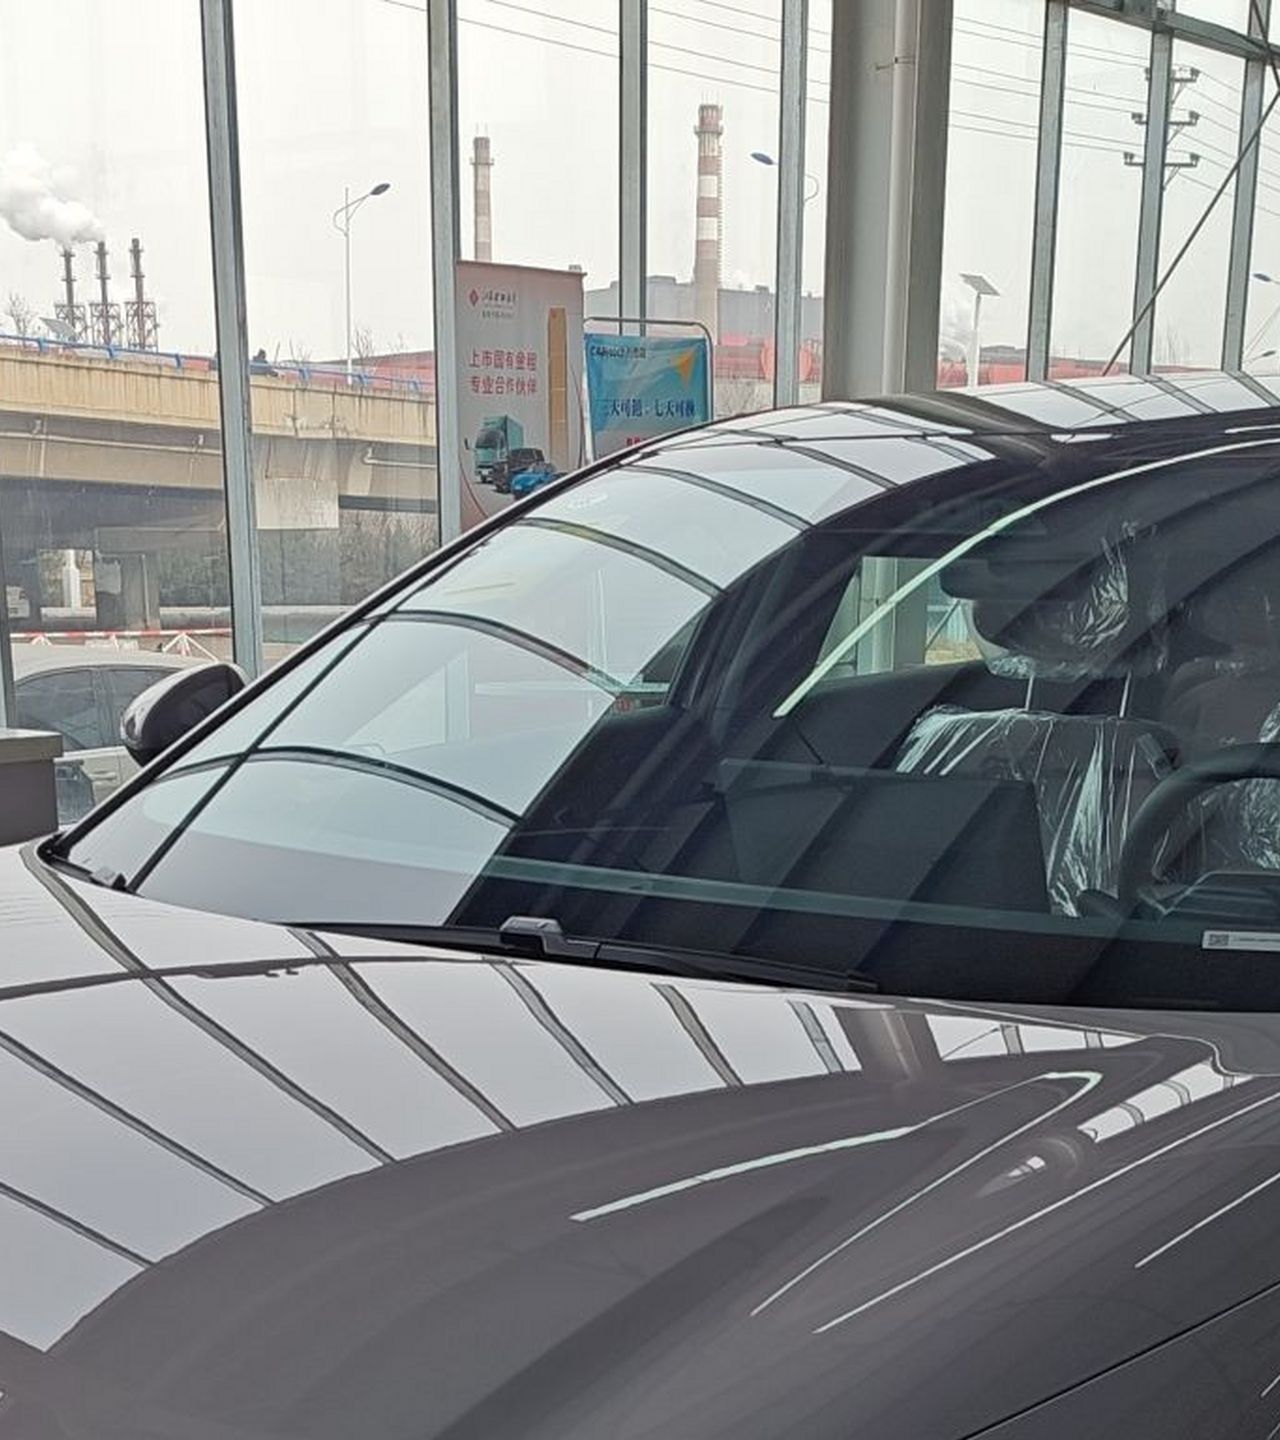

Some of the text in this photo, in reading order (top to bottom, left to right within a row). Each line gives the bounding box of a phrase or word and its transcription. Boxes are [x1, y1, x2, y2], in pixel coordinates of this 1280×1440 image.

[470, 375, 538, 397] 专业合作伙伴
